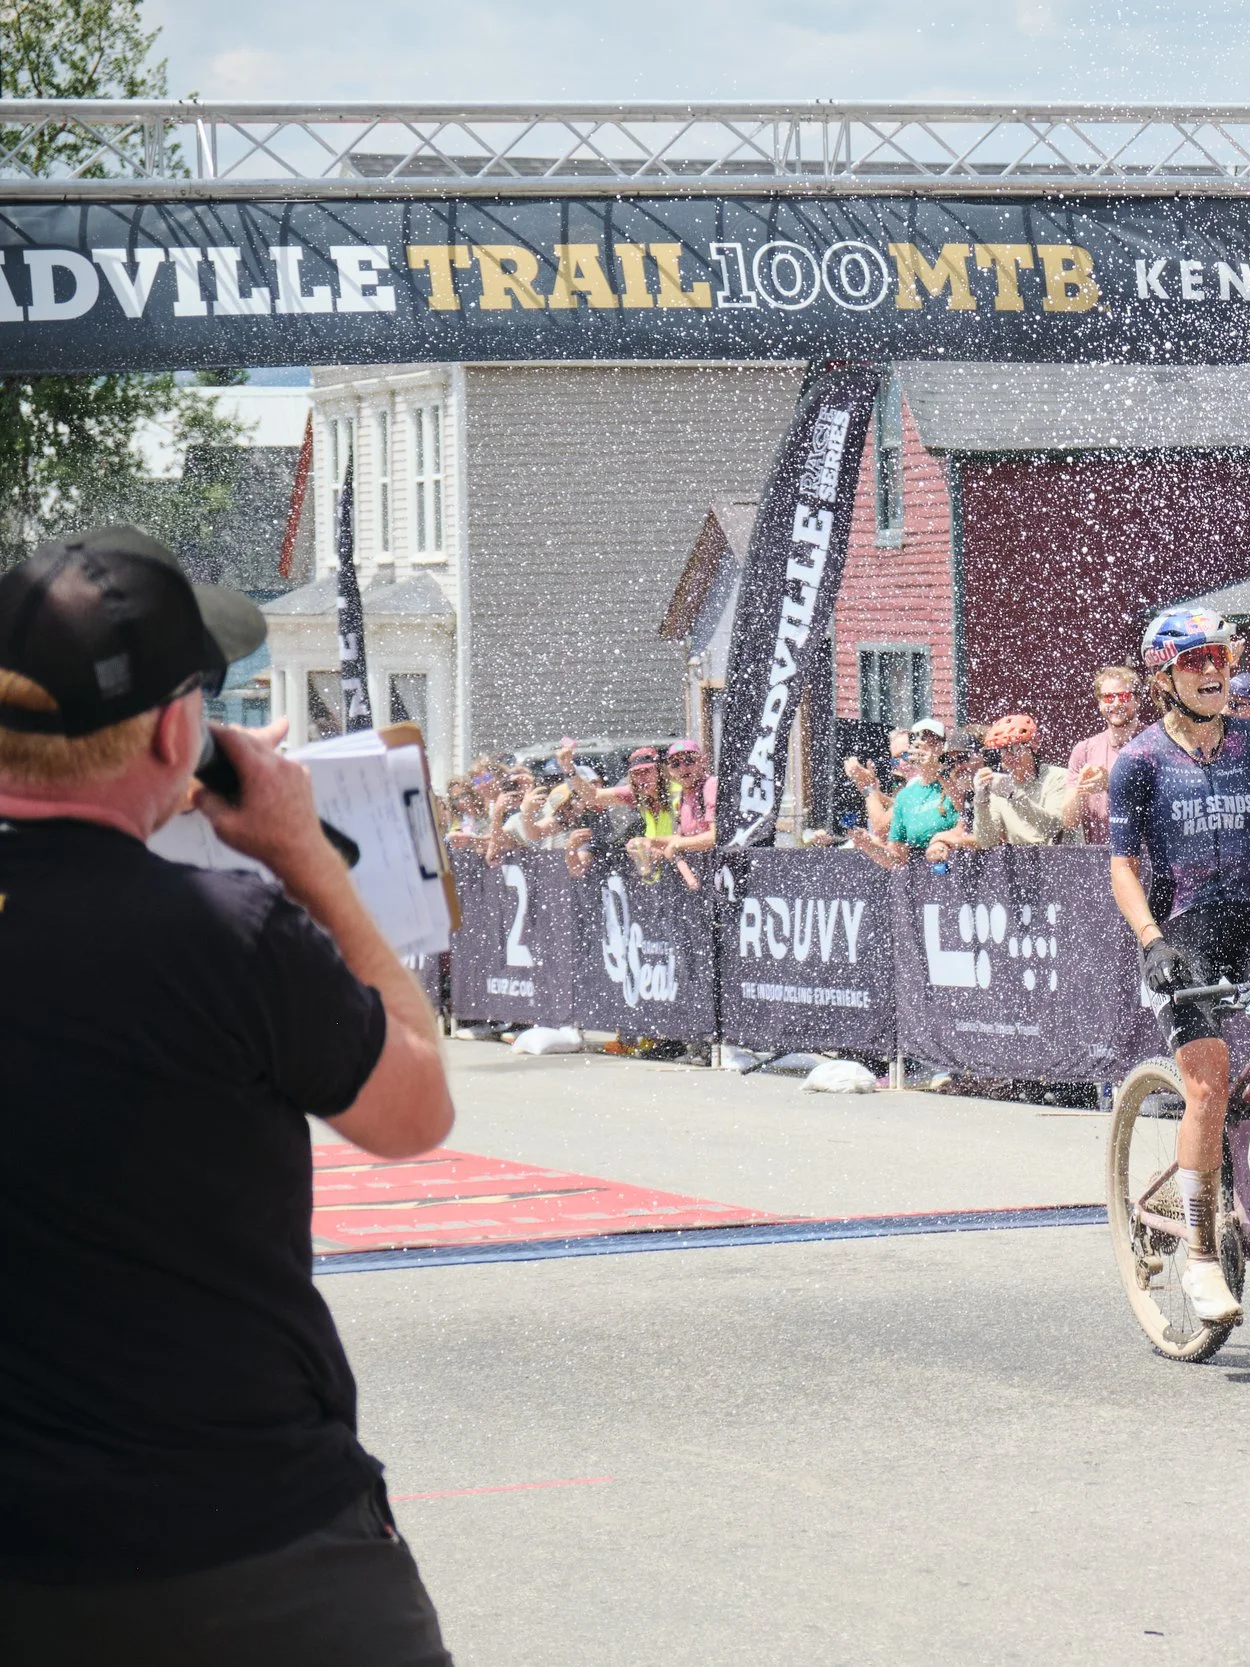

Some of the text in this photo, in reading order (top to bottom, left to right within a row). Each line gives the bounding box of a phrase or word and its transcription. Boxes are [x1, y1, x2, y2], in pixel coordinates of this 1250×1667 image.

[406, 242, 713, 311] TRAIL
[711, 240, 888, 311] 100
[888, 242, 1100, 312] MTB
[800, 407, 838, 498] RACE
[819, 409, 850, 503] SERIES
[1171, 798, 1204, 821] SHE
[1183, 813, 1245, 836] RACING
[739, 897, 866, 963] ROUVY
